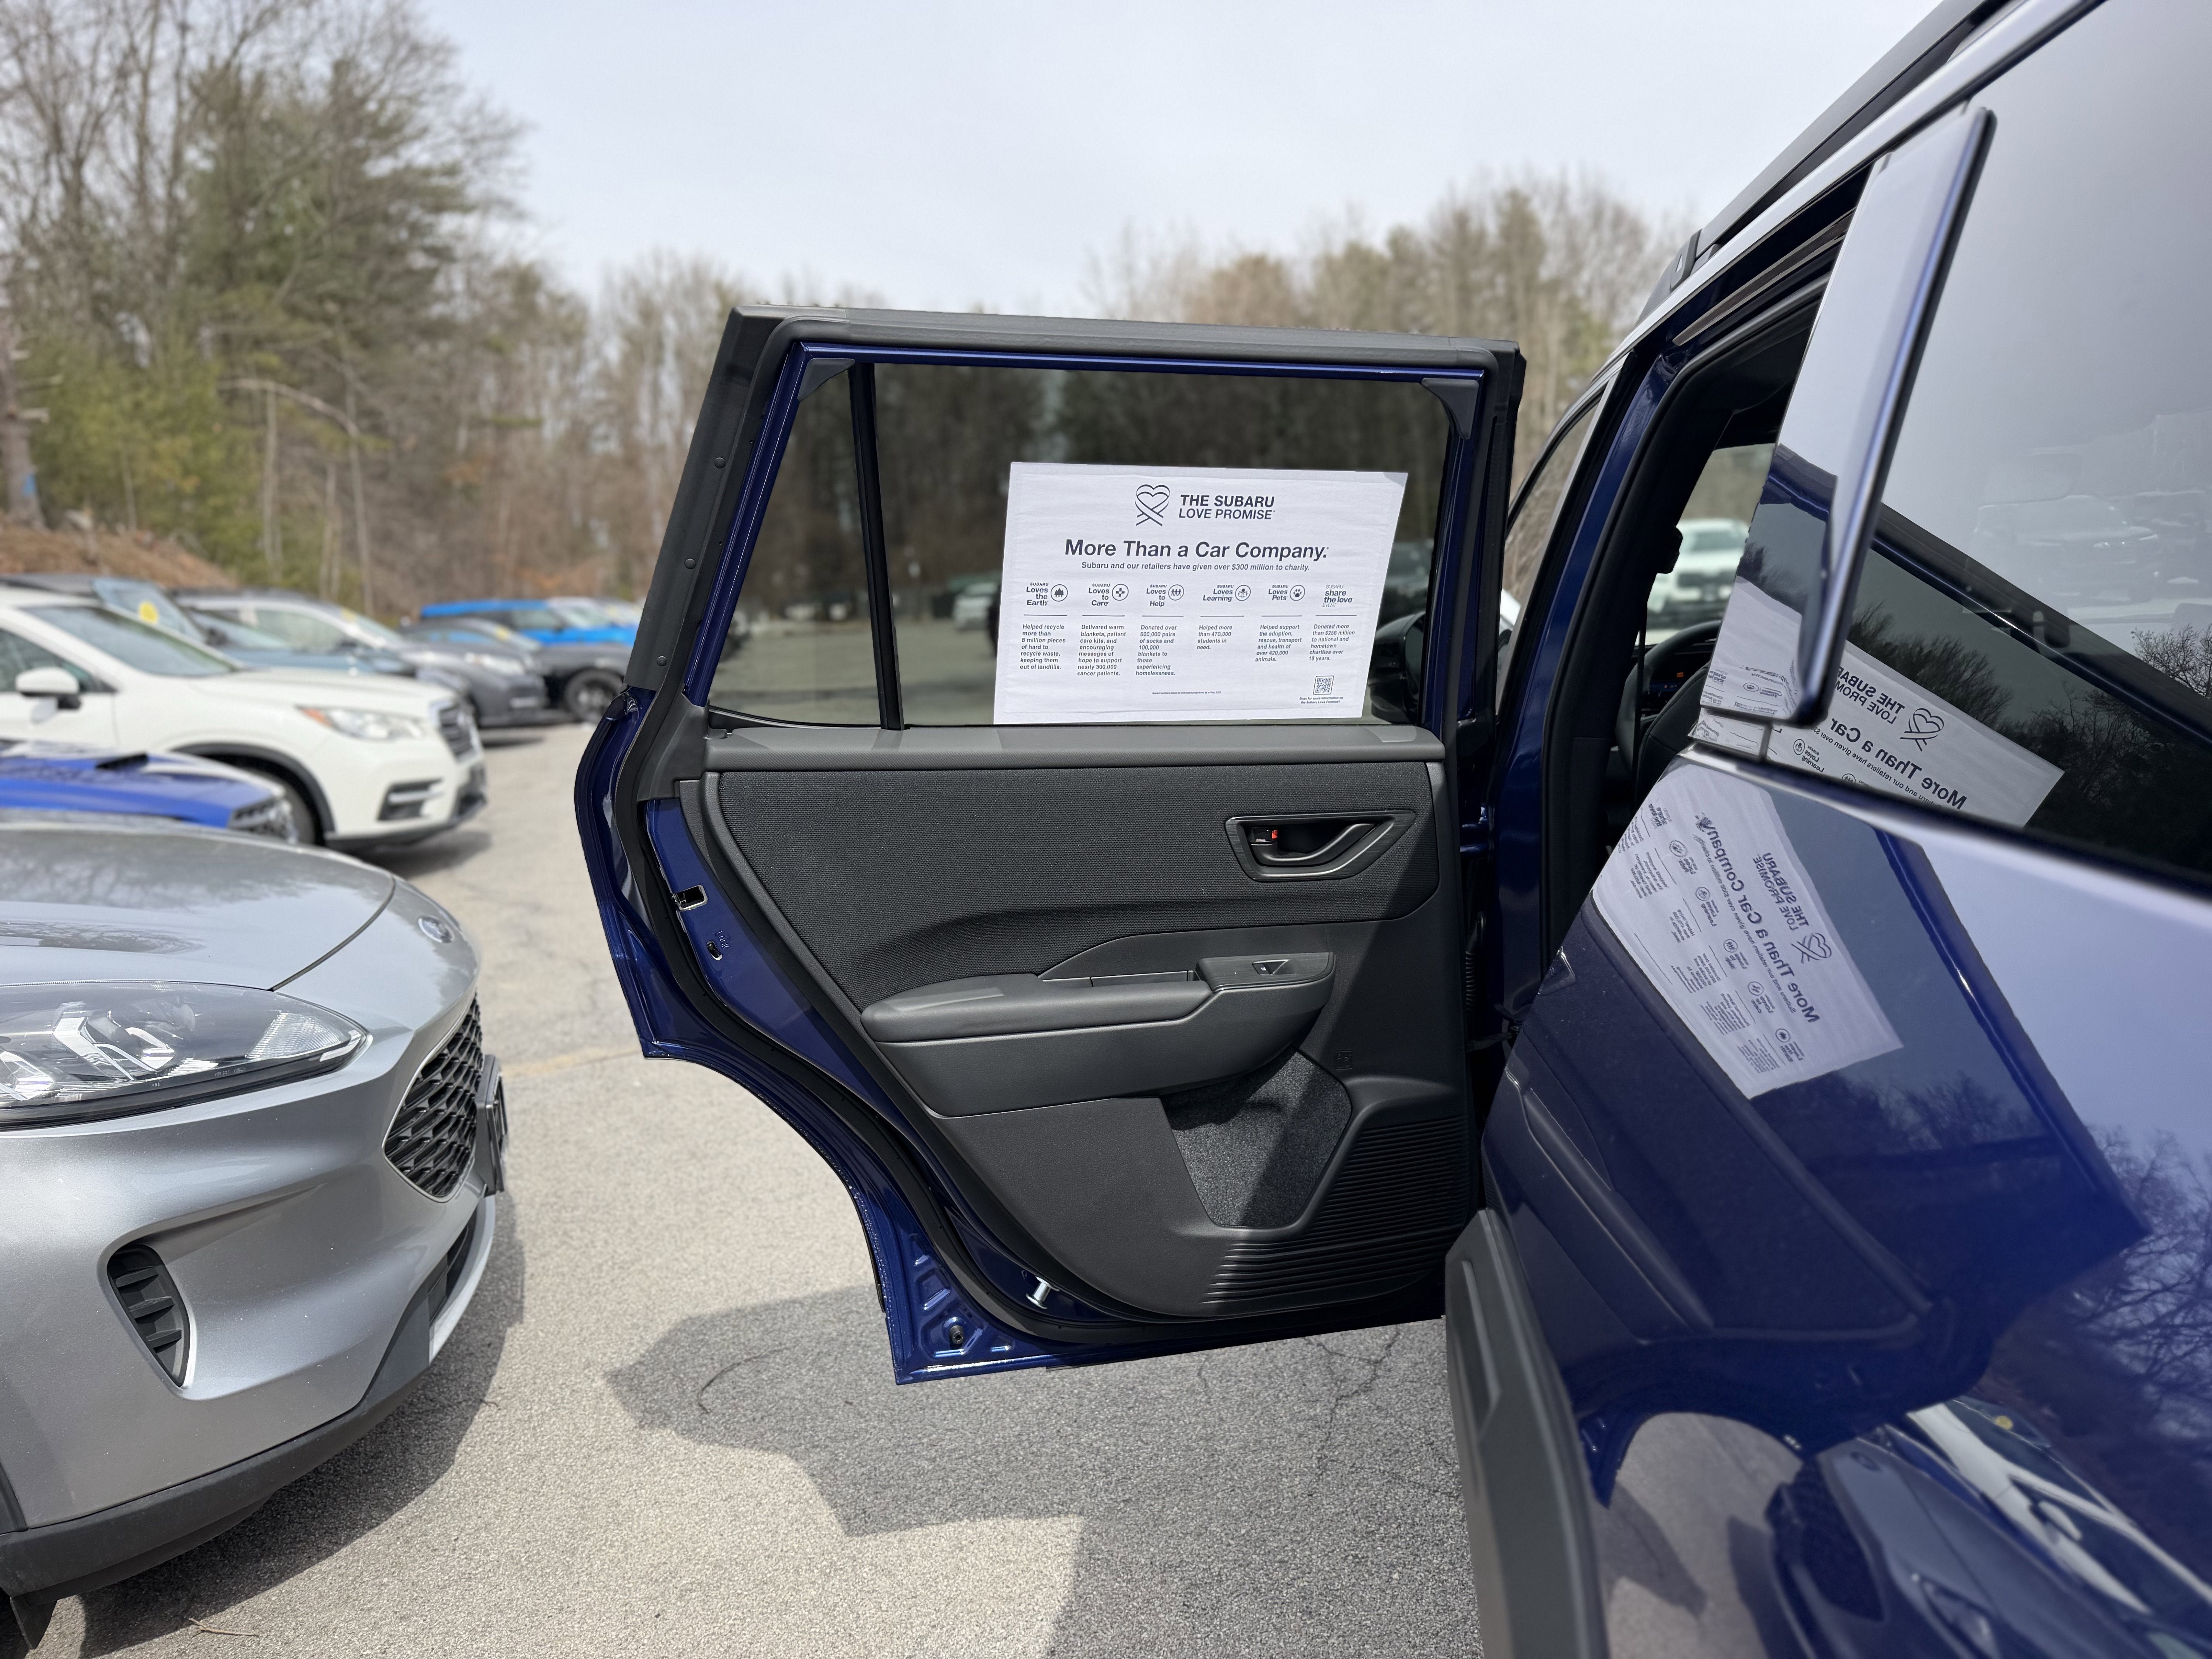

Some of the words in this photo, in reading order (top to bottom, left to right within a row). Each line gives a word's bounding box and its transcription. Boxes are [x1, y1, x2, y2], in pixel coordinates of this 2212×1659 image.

[1180, 495, 1210, 507] THE
[1214, 495, 1275, 507] SUBARU
[1178, 508, 1211, 519] LOVE
[1065, 539, 1116, 556] More
[1123, 540, 1171, 557] Than
[1177, 545, 1188, 557] a
[1195, 541, 1230, 558] Car
[1285, 564, 1309, 572] charity.
